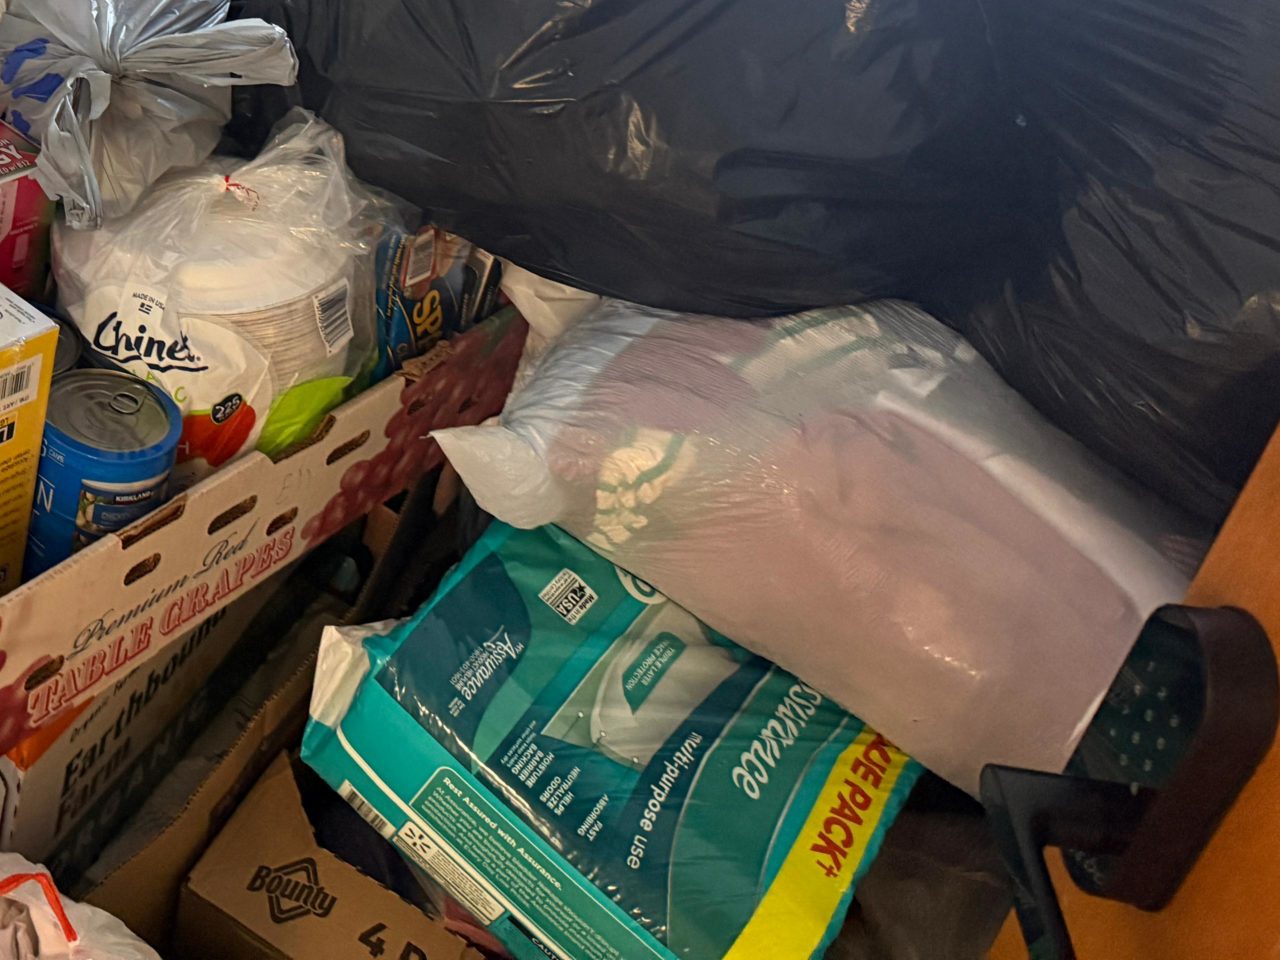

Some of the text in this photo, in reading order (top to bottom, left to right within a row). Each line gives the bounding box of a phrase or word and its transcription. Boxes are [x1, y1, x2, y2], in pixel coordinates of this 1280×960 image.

[132, 292, 149, 304] MADE
[0, 417, 9, 427] LG
[215, 396, 240, 419] 225
[48, 449, 65, 464] CANS
[115, 490, 152, 502] KIRKLAND
[66, 516, 261, 660] Premium Red
[556, 588, 580, 616] USA
[578, 594, 595, 611] Made
[27, 525, 296, 727] TABLE GRAPES
[514, 642, 525, 653] MY
[461, 632, 517, 701] Assurance
[731, 682, 823, 801] ssurance
[510, 743, 538, 775] BACKING
[517, 750, 545, 782] BARRIER
[524, 752, 555, 788] MOISTURE
[538, 775, 561, 803] ODORS
[545, 766, 581, 810] NEUTRALIZE
[553, 791, 575, 816] HELPS
[626, 731, 703, 870] multi-purpose use
[576, 793, 610, 837] ABSORBING
[586, 820, 604, 842] FAST
[442, 776, 564, 892] Rest Assured with Assurance.
[246, 865, 338, 918] Bounty
[358, 922, 389, 958] 4
